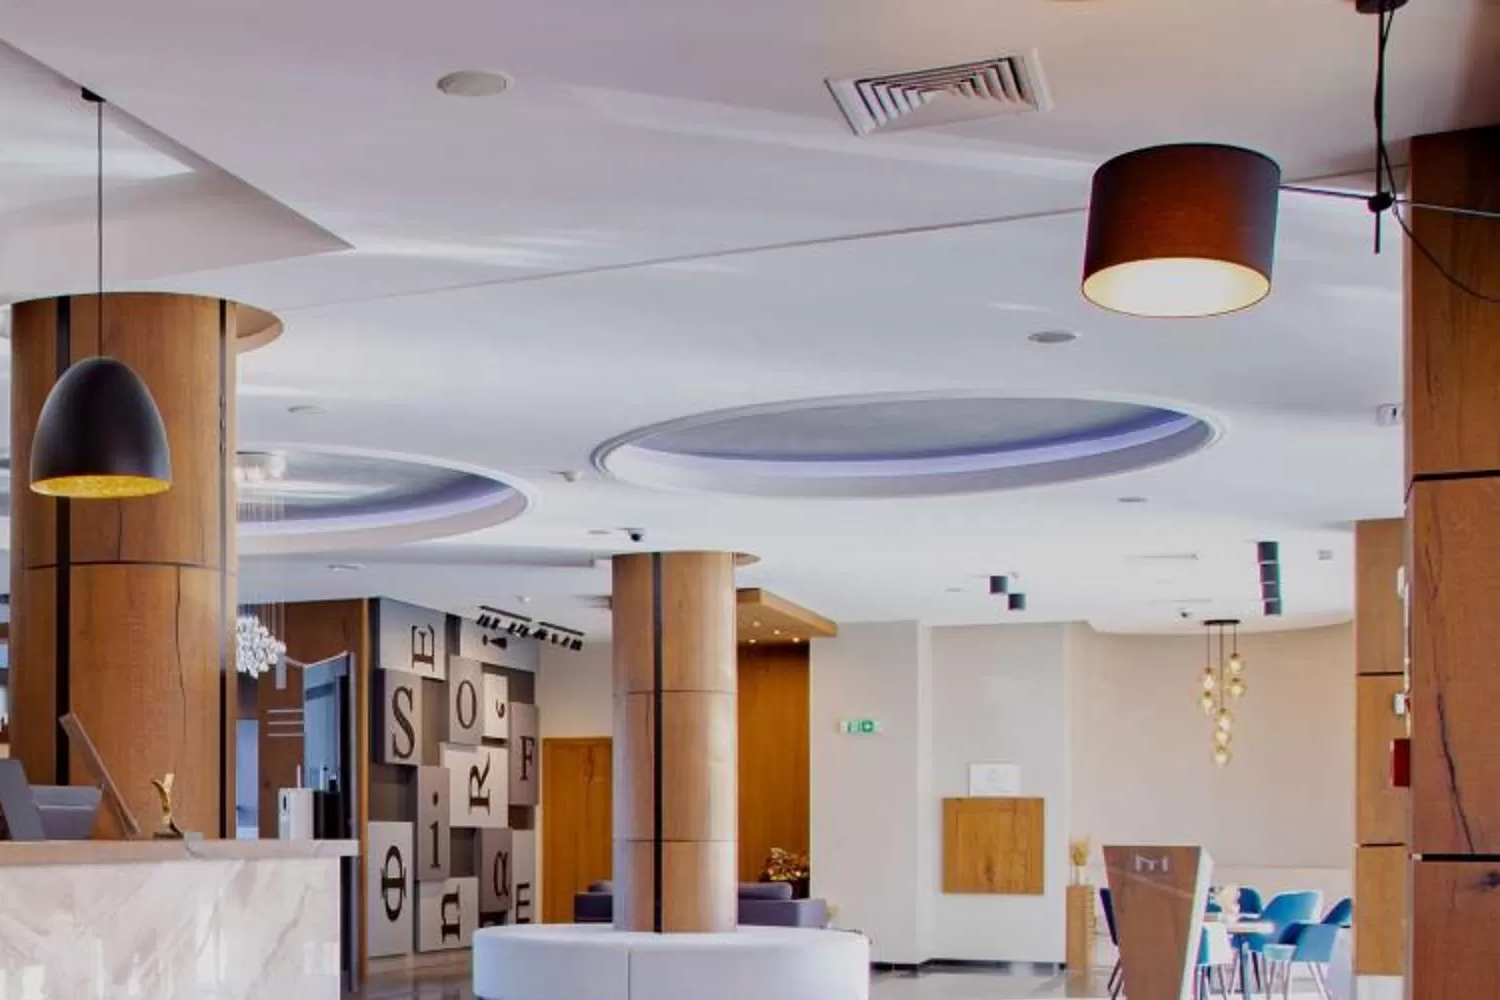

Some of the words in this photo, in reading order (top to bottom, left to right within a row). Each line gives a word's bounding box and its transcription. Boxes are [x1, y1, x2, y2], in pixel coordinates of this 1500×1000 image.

[392, 686, 415, 759] S
[456, 679, 477, 729] O
[467, 752, 491, 816] R
[520, 736, 535, 781] F
